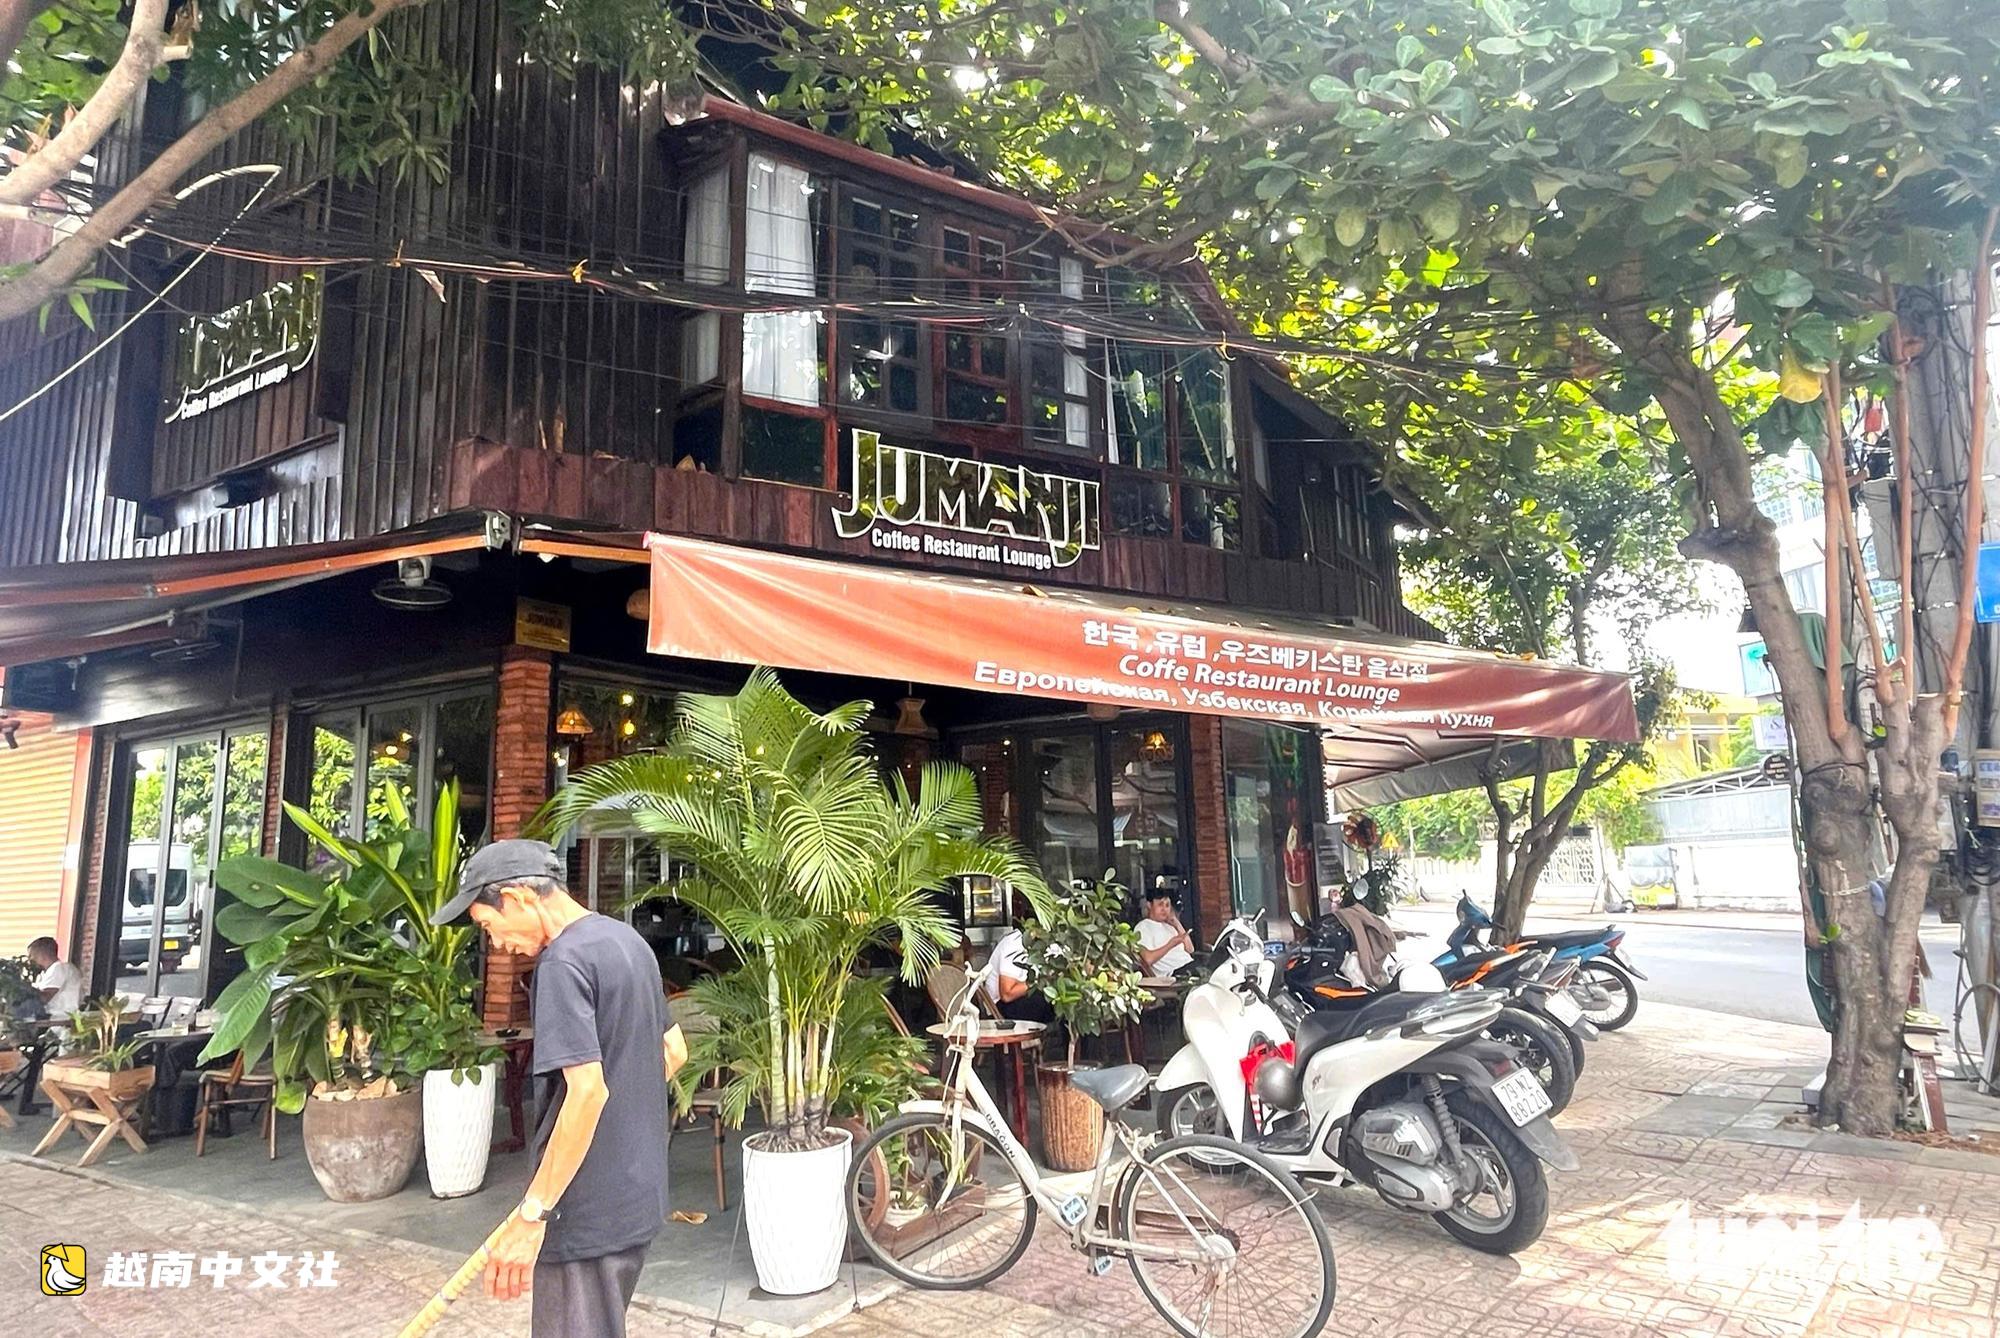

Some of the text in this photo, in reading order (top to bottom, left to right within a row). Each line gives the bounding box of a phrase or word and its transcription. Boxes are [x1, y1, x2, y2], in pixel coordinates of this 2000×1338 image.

[831, 428, 1100, 568] JUMANJI
[872, 528, 1052, 570] Coffee Restaurant Lounge
[1082, 620, 1139, 650] 한국
[1367, 656, 1429, 683] 음식점
[1119, 654, 1400, 704] Coffe Restaurant Lounge
[1182, 687, 1314, 718] Узбекская,
[985, 1113, 1016, 1159] DRAGON
